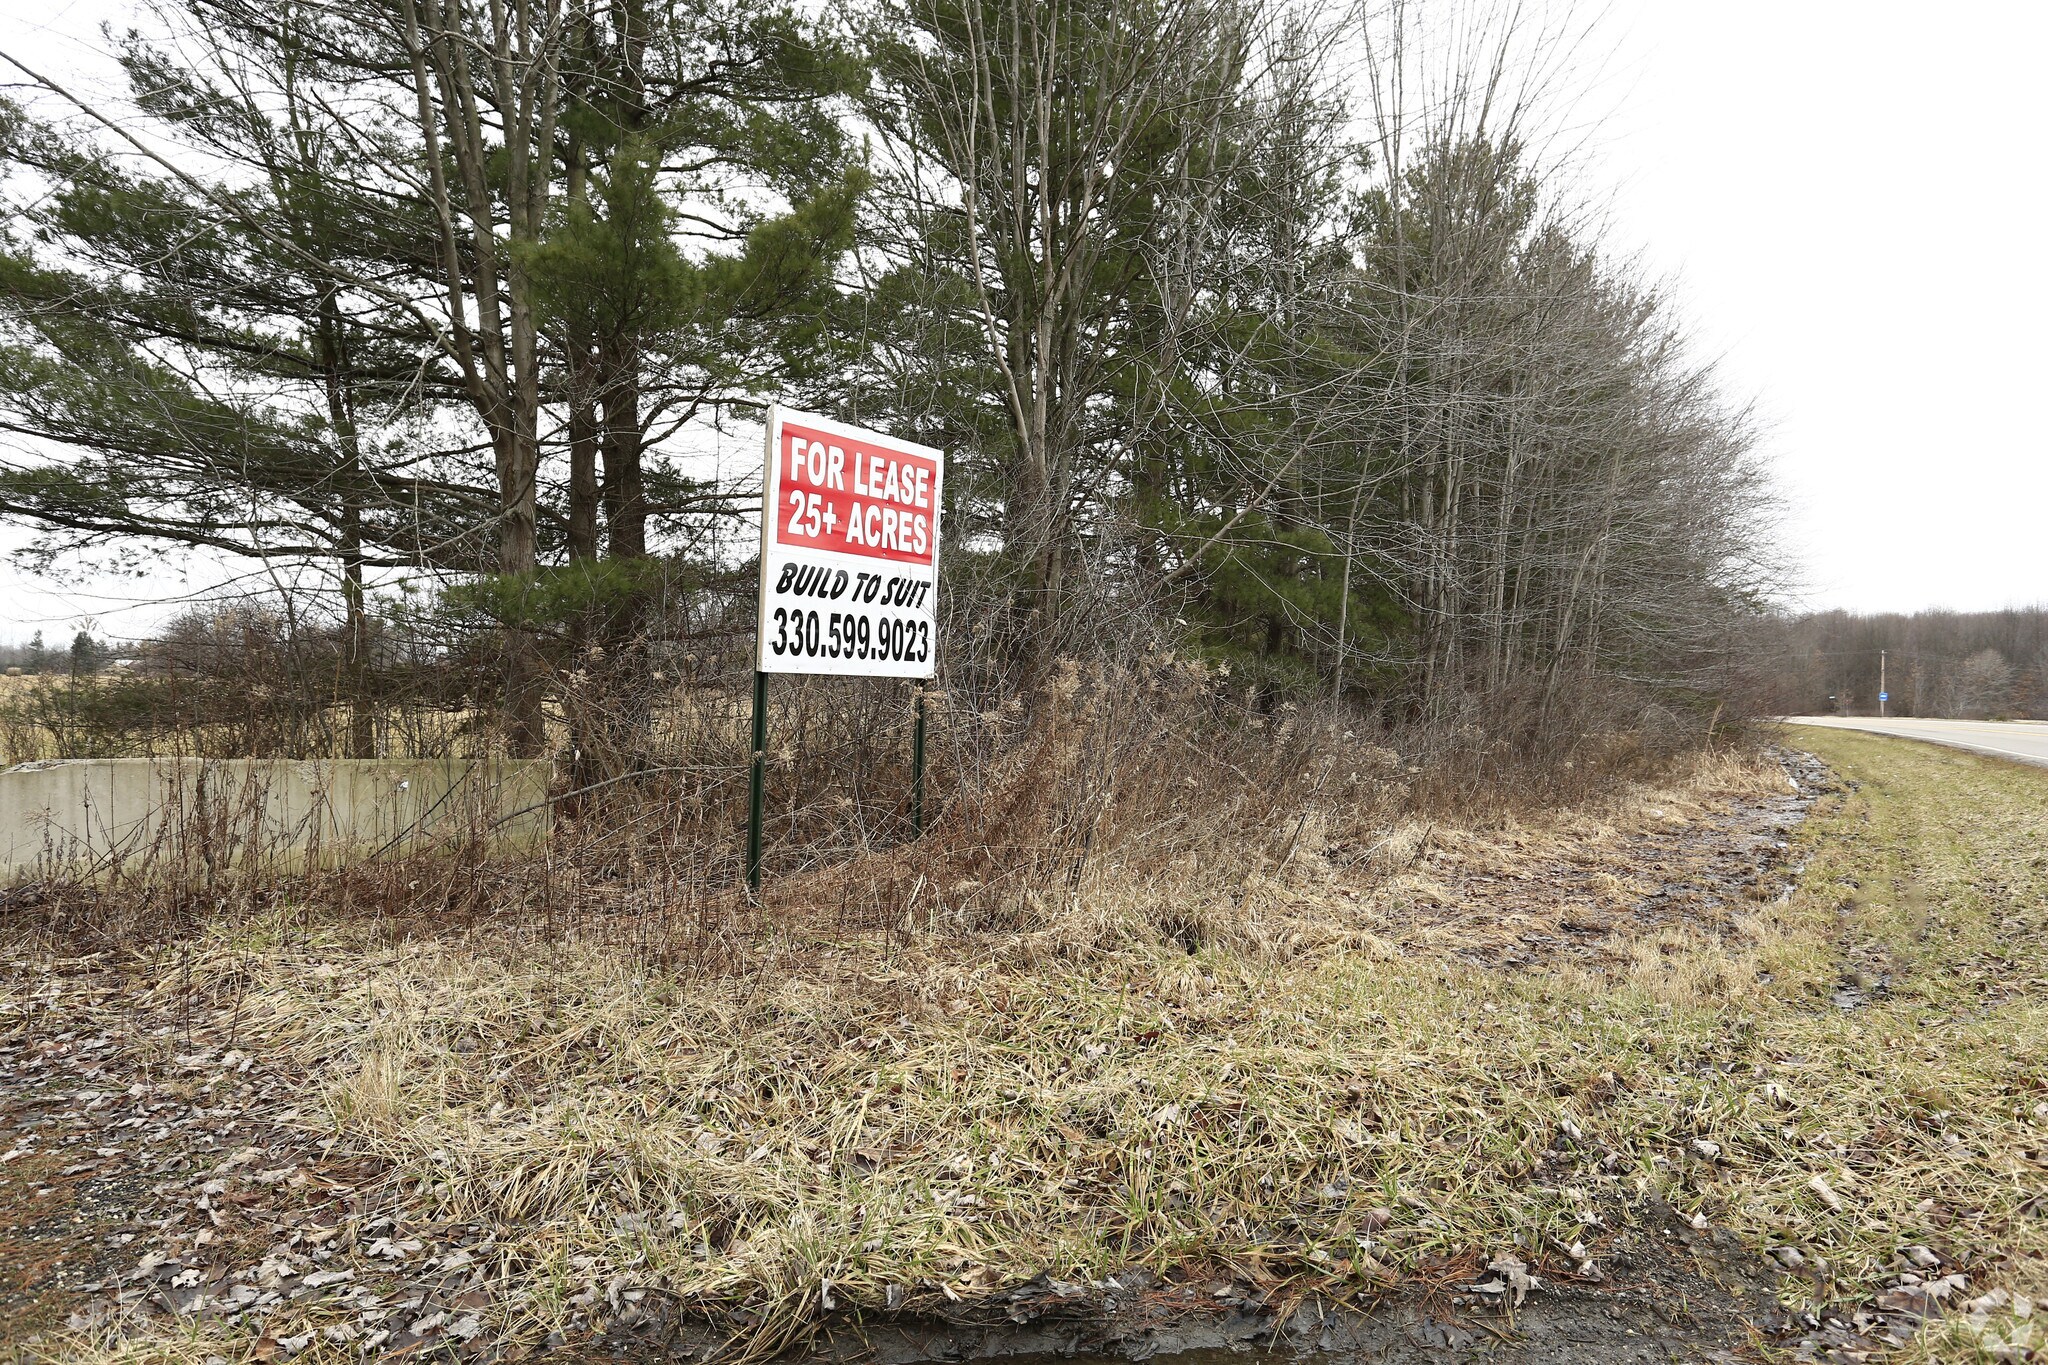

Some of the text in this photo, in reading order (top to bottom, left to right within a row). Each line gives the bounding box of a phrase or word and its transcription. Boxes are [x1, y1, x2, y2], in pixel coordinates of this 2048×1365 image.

[790, 436, 930, 508] FOR LEASE
[787, 489, 927, 555] 25+ ACRES
[776, 562, 932, 609] BUILD TO SUIT
[772, 607, 929, 663] 330.599.9023
